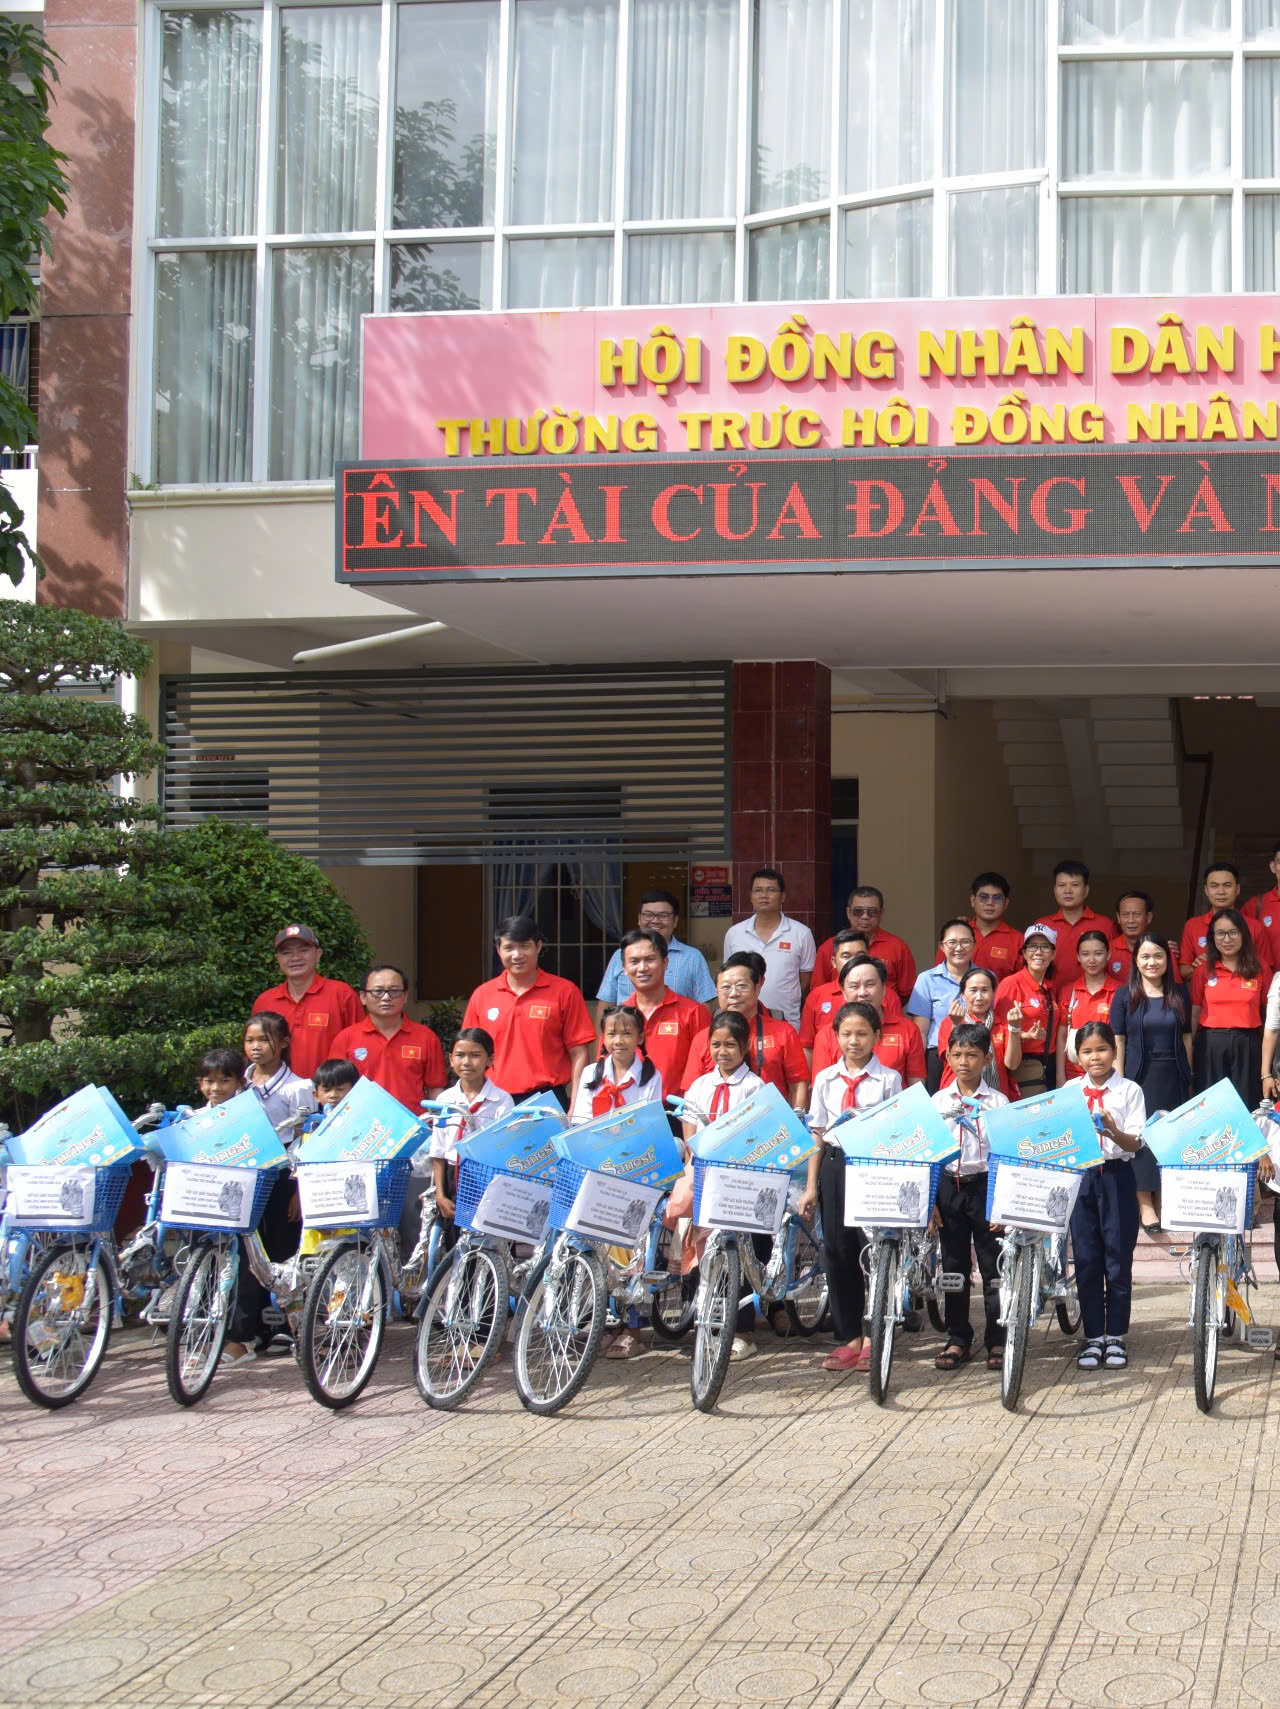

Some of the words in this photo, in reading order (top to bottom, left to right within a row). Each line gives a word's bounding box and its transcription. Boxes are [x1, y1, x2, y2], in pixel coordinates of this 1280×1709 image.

[600, 325, 700, 394] HỘI
[725, 314, 896, 381] ĐỒNG
[917, 316, 1085, 376] NHÂN
[1110, 311, 1235, 373] DÂN
[436, 406, 658, 456] THƯỜNG
[842, 396, 929, 448] HỘI
[951, 389, 1105, 444] ĐỒNG
[1127, 391, 1278, 441] NHÂN
[345, 473, 465, 549] ÊN
[485, 472, 629, 545] TÀI
[651, 463, 822, 542] CỦA
[846, 459, 1092, 538] ĐẢNG
[1118, 460, 1235, 534] VÀ
[506, 1139, 556, 1173] Sanes
[600, 1144, 656, 1175] Sanest
[1017, 1128, 1074, 1158] Sanest
